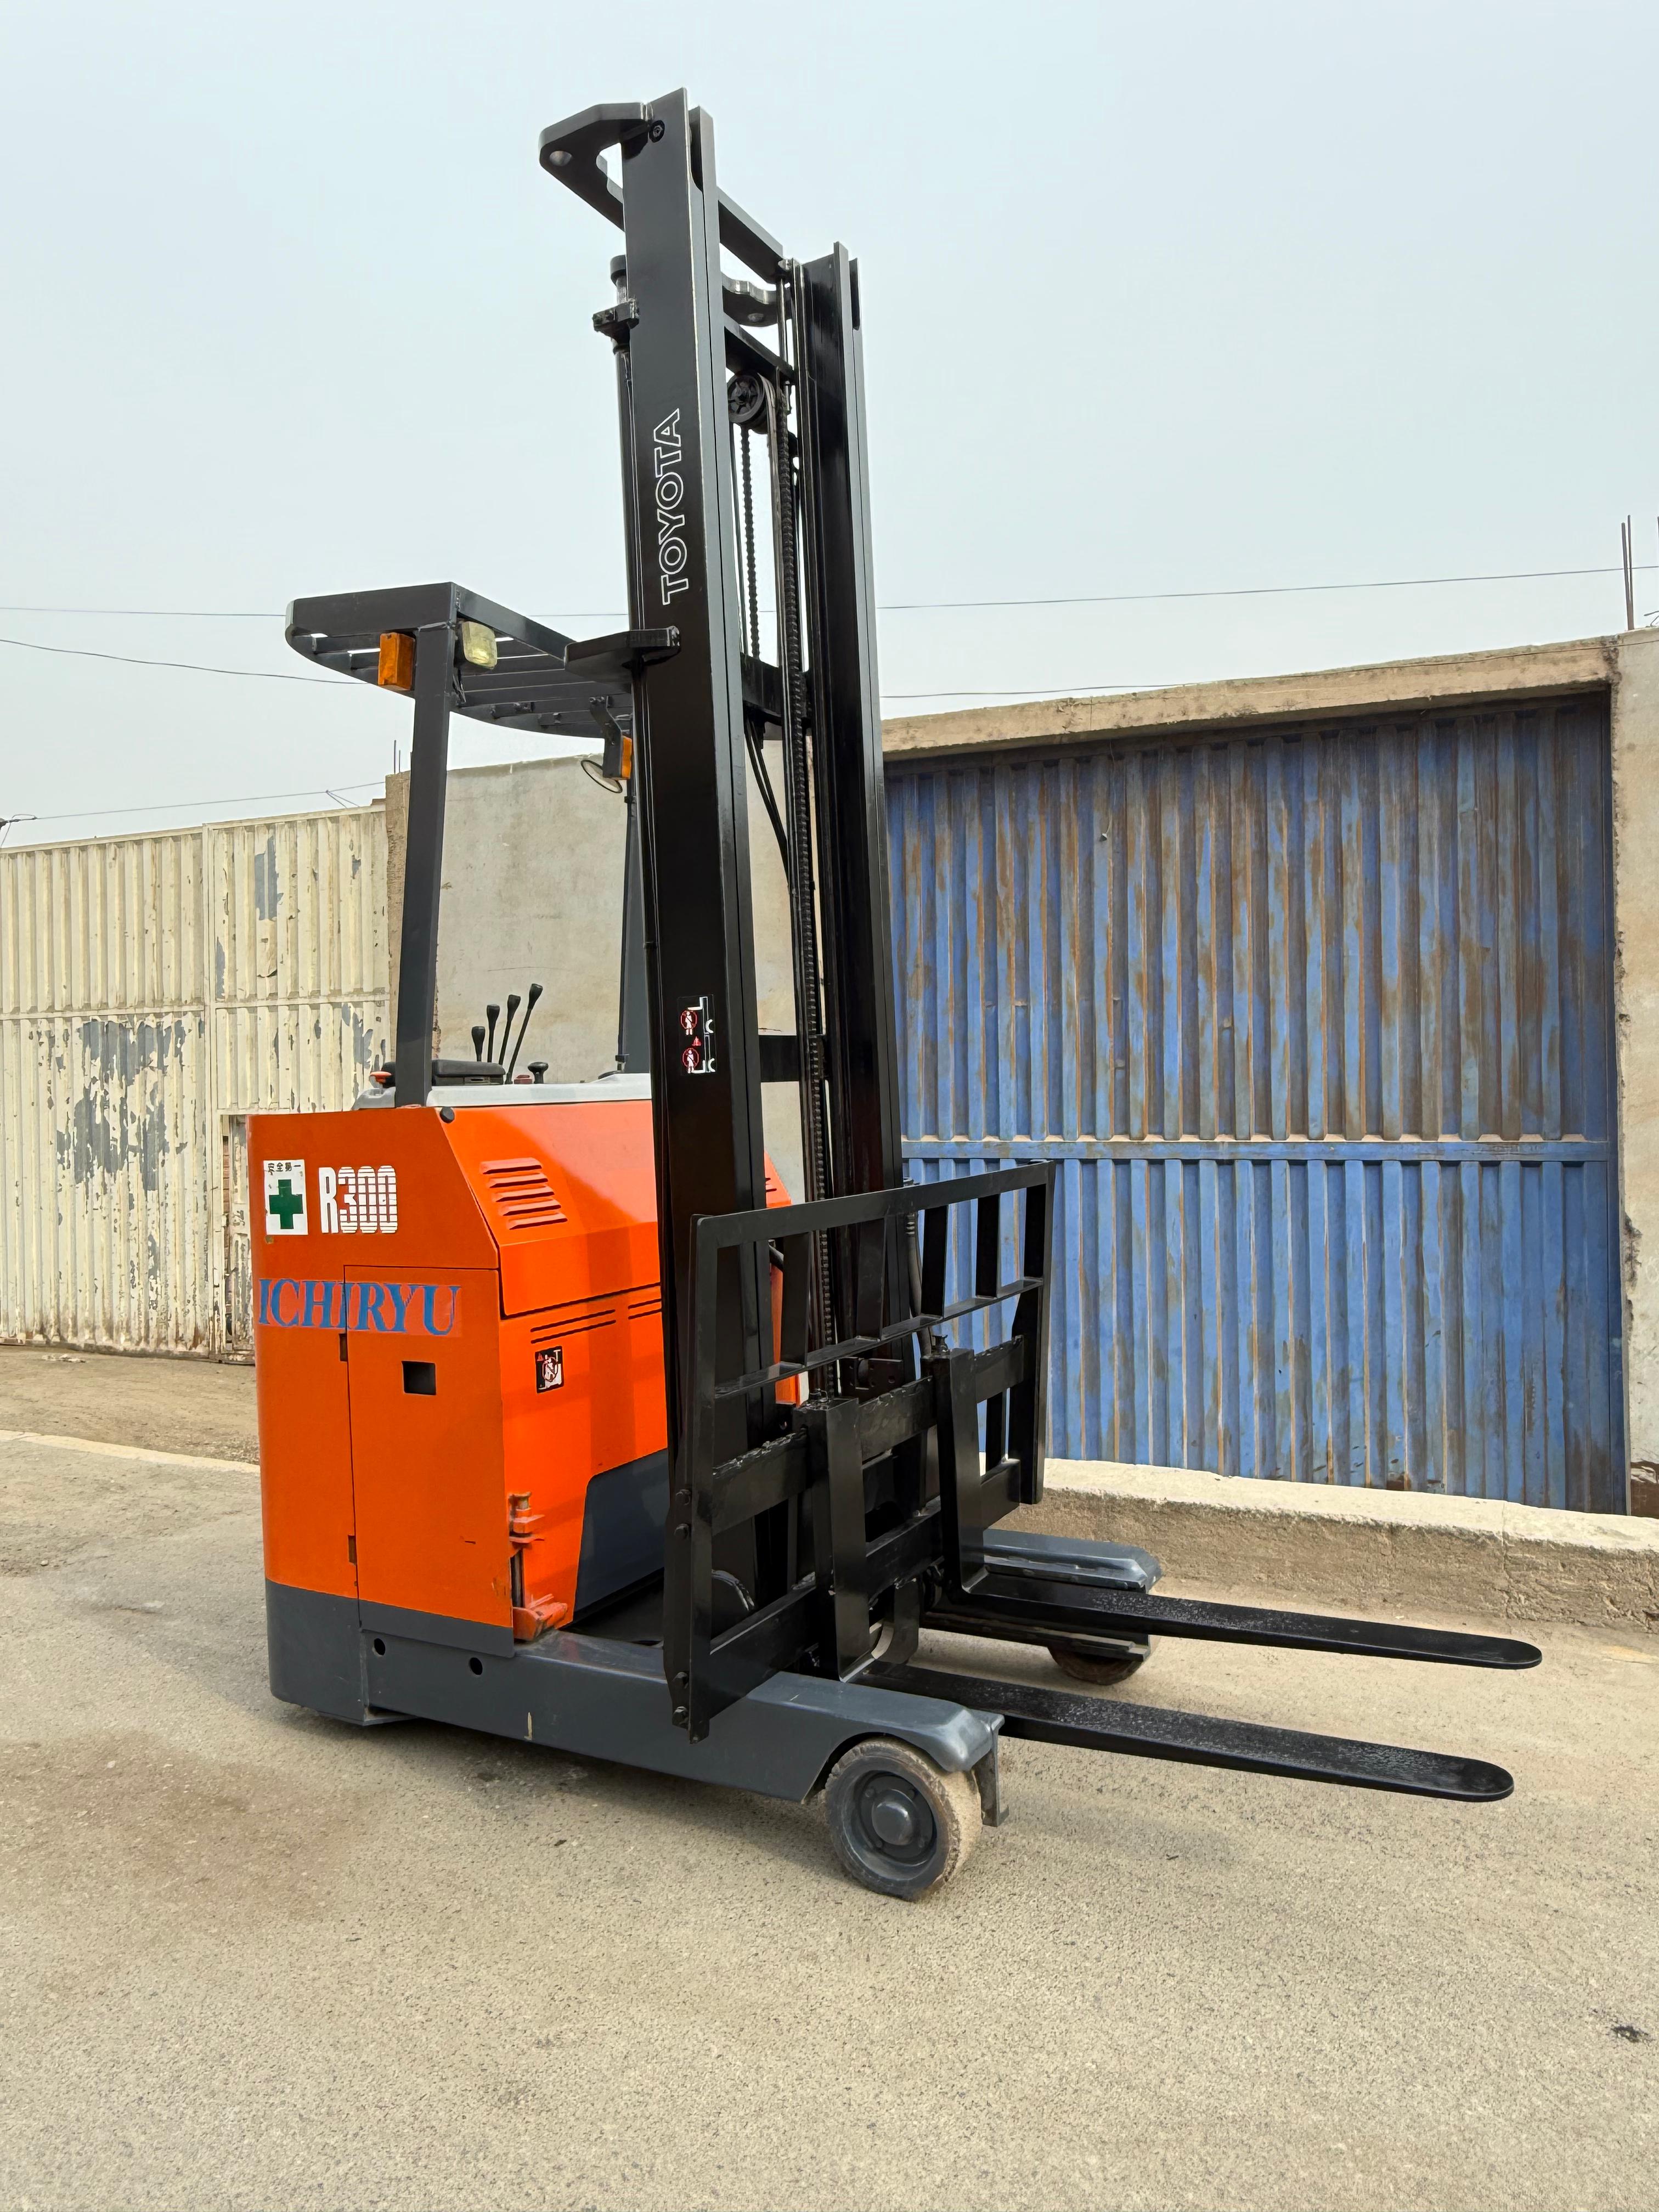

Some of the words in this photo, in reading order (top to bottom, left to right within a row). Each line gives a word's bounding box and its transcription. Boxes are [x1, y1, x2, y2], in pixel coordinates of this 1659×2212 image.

[653, 408, 689, 605] TOYOTA
[319, 1165, 398, 1234] R300
[258, 1278, 461, 1335] ICHIRYU
